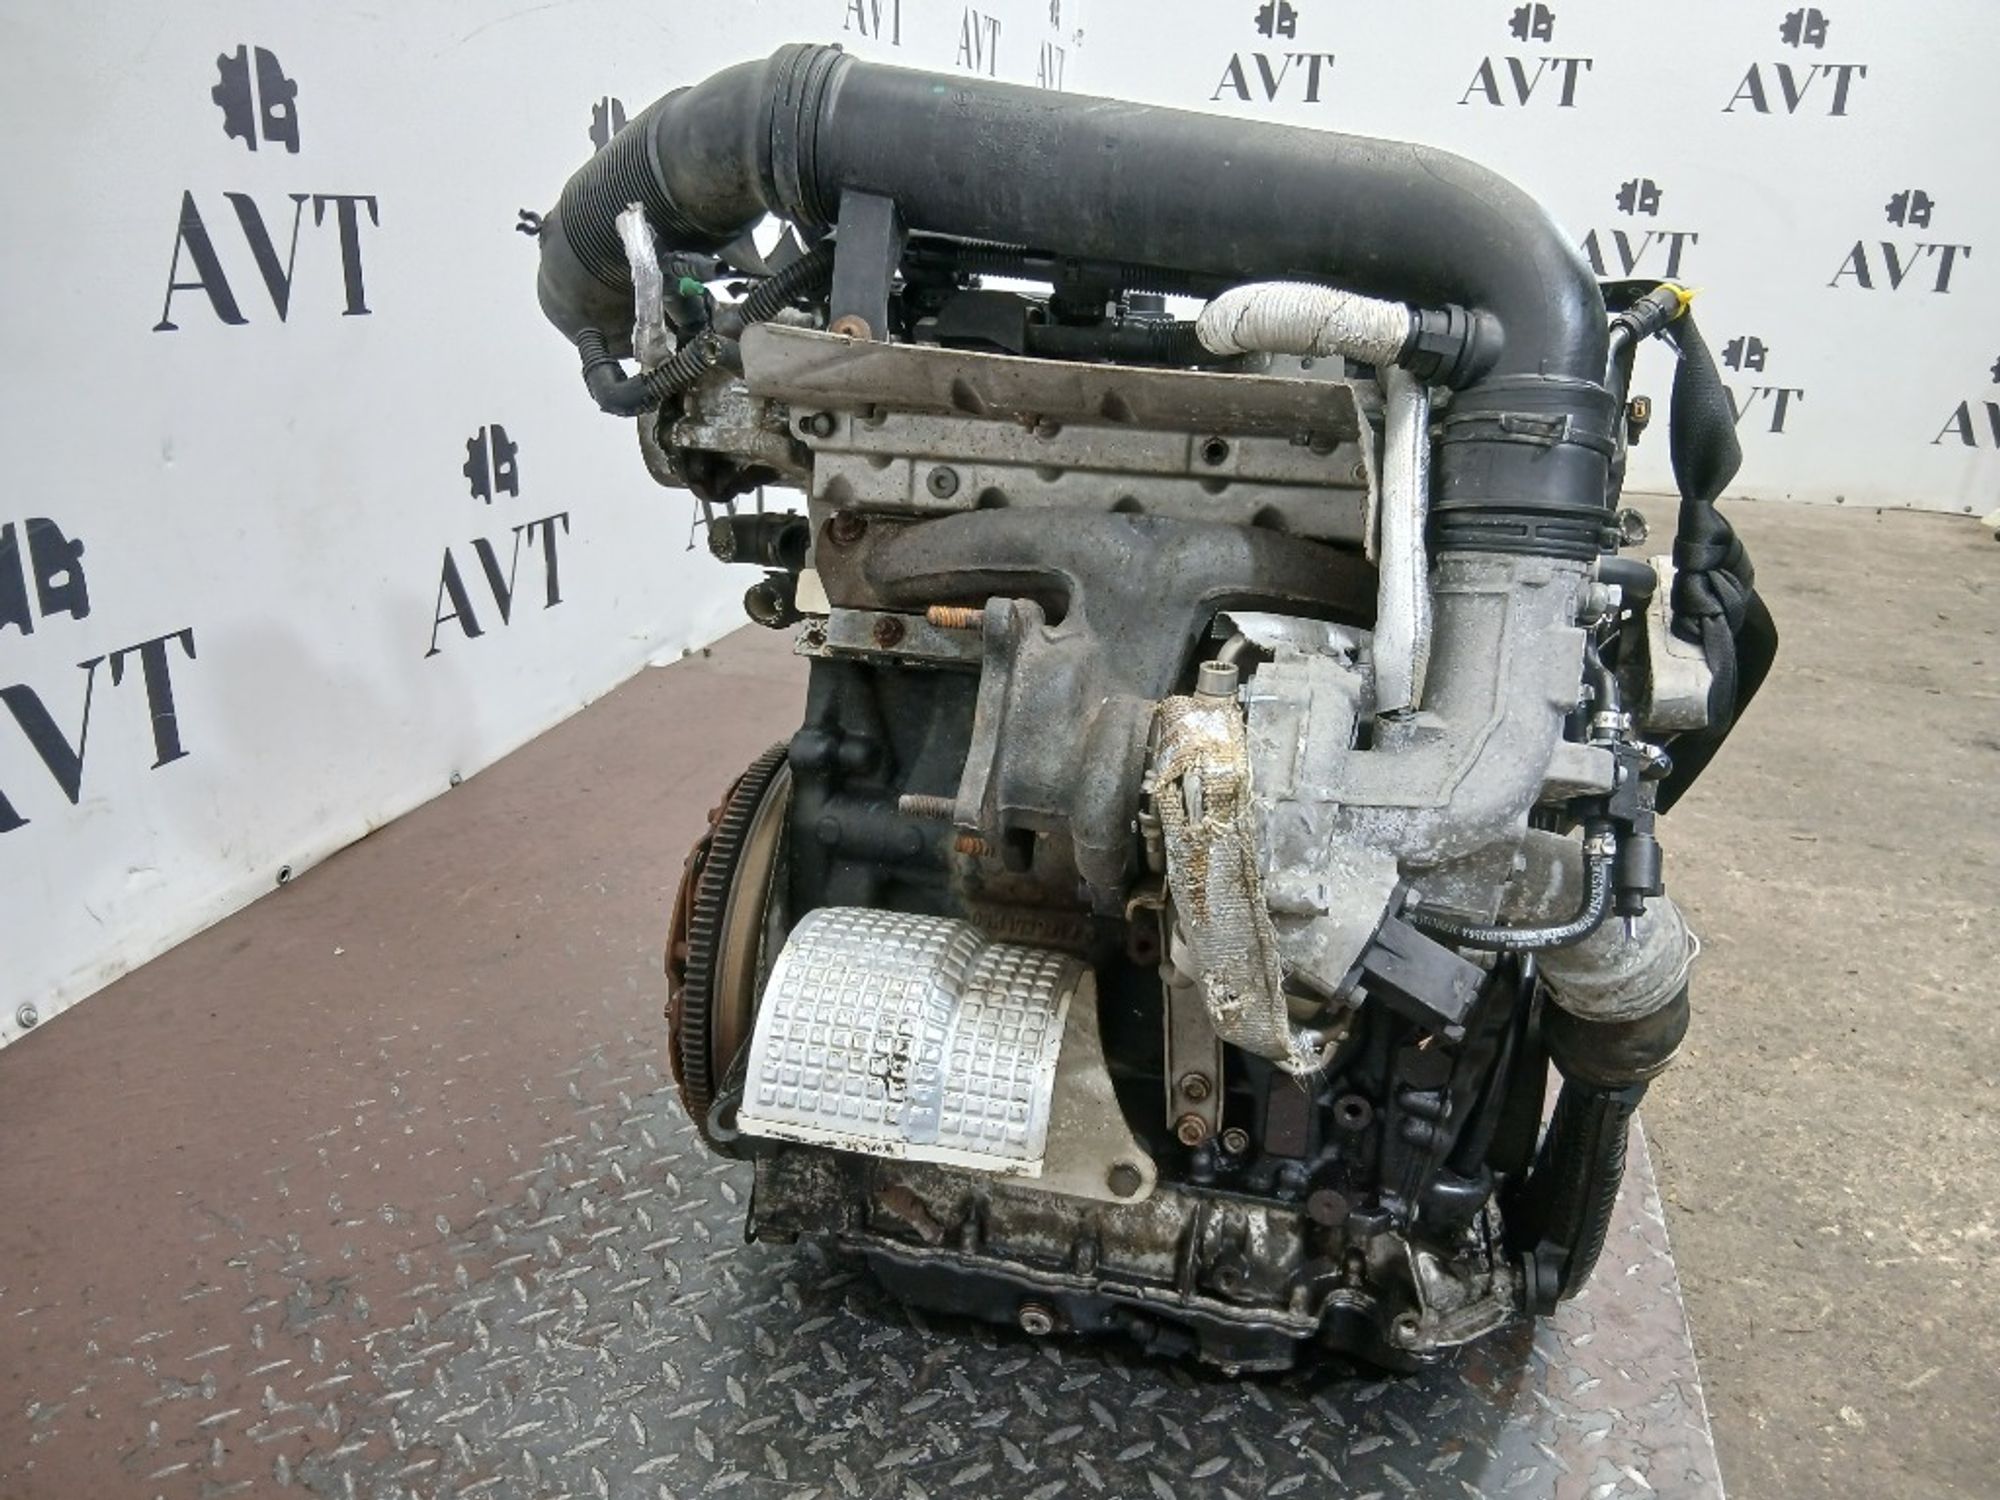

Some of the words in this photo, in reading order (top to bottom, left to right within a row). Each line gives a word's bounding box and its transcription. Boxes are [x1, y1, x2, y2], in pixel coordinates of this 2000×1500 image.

[956, 5, 1001, 77] AVT
[1210, 52, 1335, 102] AVT
[1457, 56, 1593, 107] AVT
[1722, 62, 1867, 116] AVT
[152, 190, 379, 332] AVT
[1580, 228, 1698, 280] AVT
[1828, 240, 1972, 294] AVT
[1722, 385, 1804, 433] VT
[424, 512, 570, 659] AVT
[0, 628, 196, 833] VT
